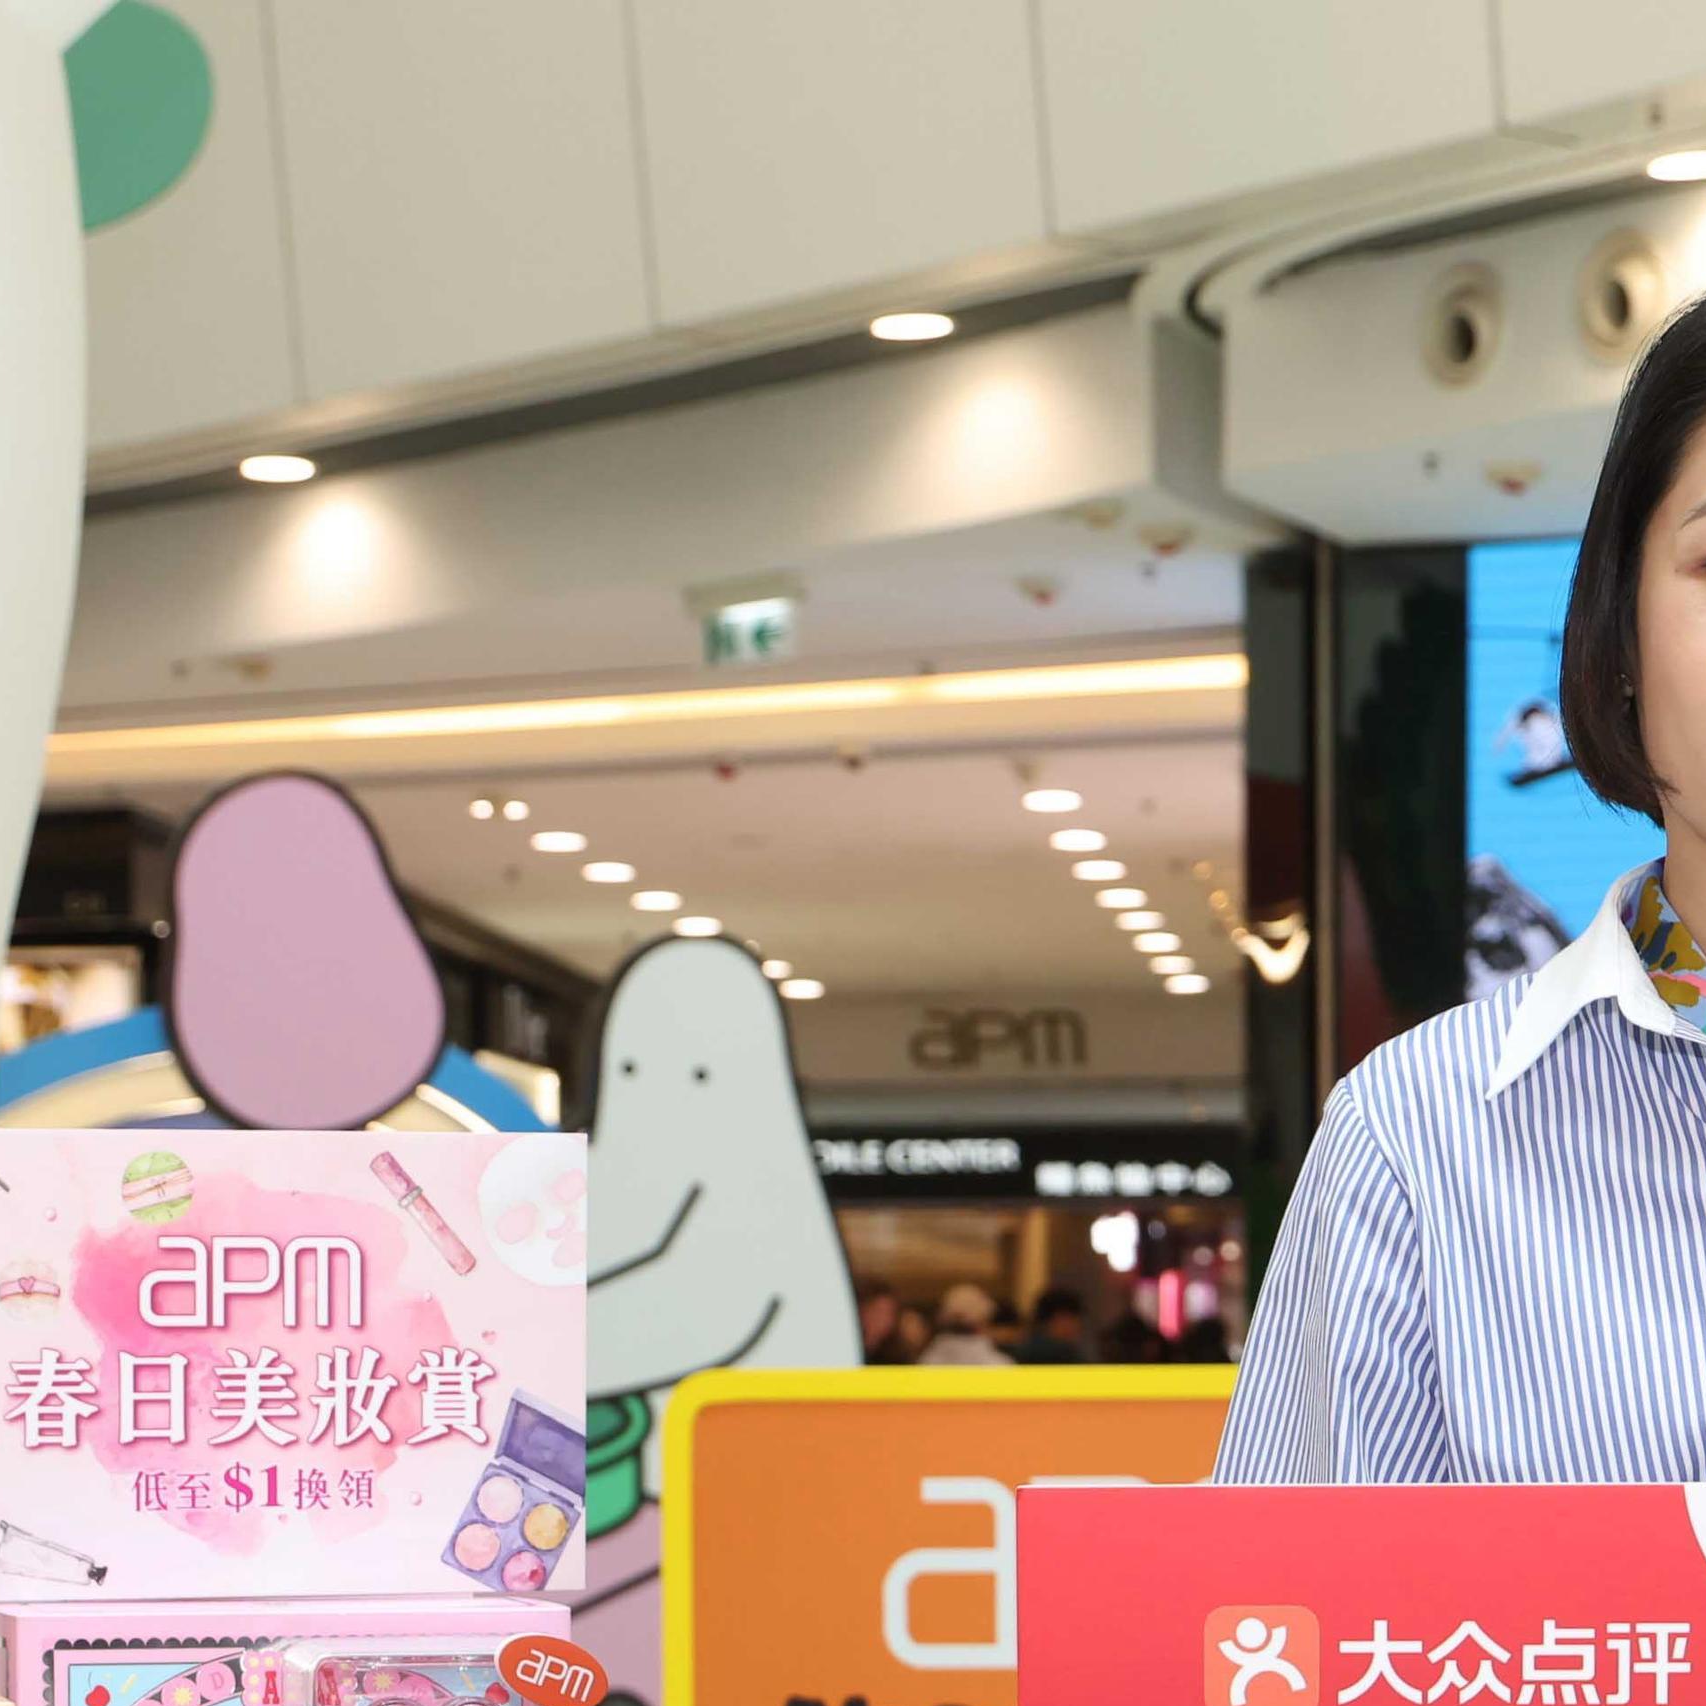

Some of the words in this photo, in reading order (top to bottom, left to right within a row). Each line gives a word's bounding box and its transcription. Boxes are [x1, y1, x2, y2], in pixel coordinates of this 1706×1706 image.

[909, 1007, 1088, 1069] apm
[886, 1138, 1020, 1175] CENTER
[138, 1236, 363, 1329] apm
[3, 1346, 494, 1450] 春日美妝賞
[130, 1462, 375, 1513] 低至$1換領
[515, 1647, 595, 1702] apm
[1336, 1618, 1693, 1706] 大众点评
